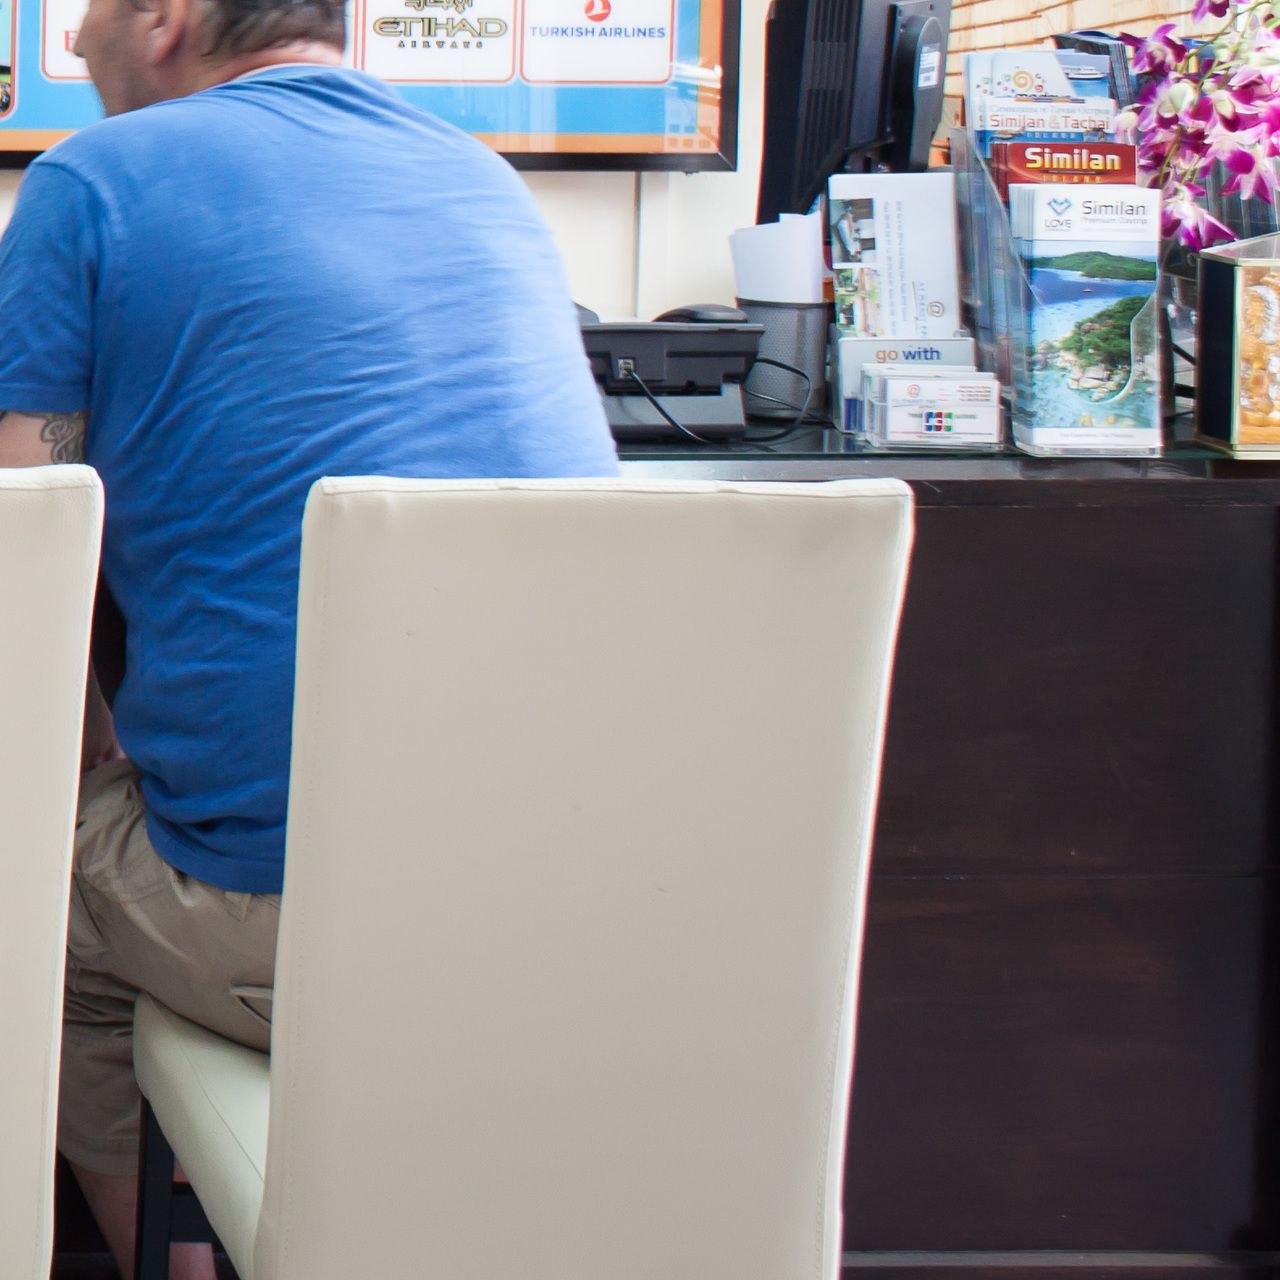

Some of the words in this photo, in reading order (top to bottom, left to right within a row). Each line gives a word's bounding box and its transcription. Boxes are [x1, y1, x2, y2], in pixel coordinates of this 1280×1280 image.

[371, 16, 509, 39] ETIHAD
[529, 25, 596, 38] TURKISH
[599, 26, 667, 39] AIRLINES
[989, 114, 1046, 130] Similan
[1061, 116, 1111, 131] Tachai
[1024, 146, 1122, 172] Similan
[1081, 199, 1147, 216] Similan
[875, 349, 899, 364] go
[902, 346, 941, 361] with
